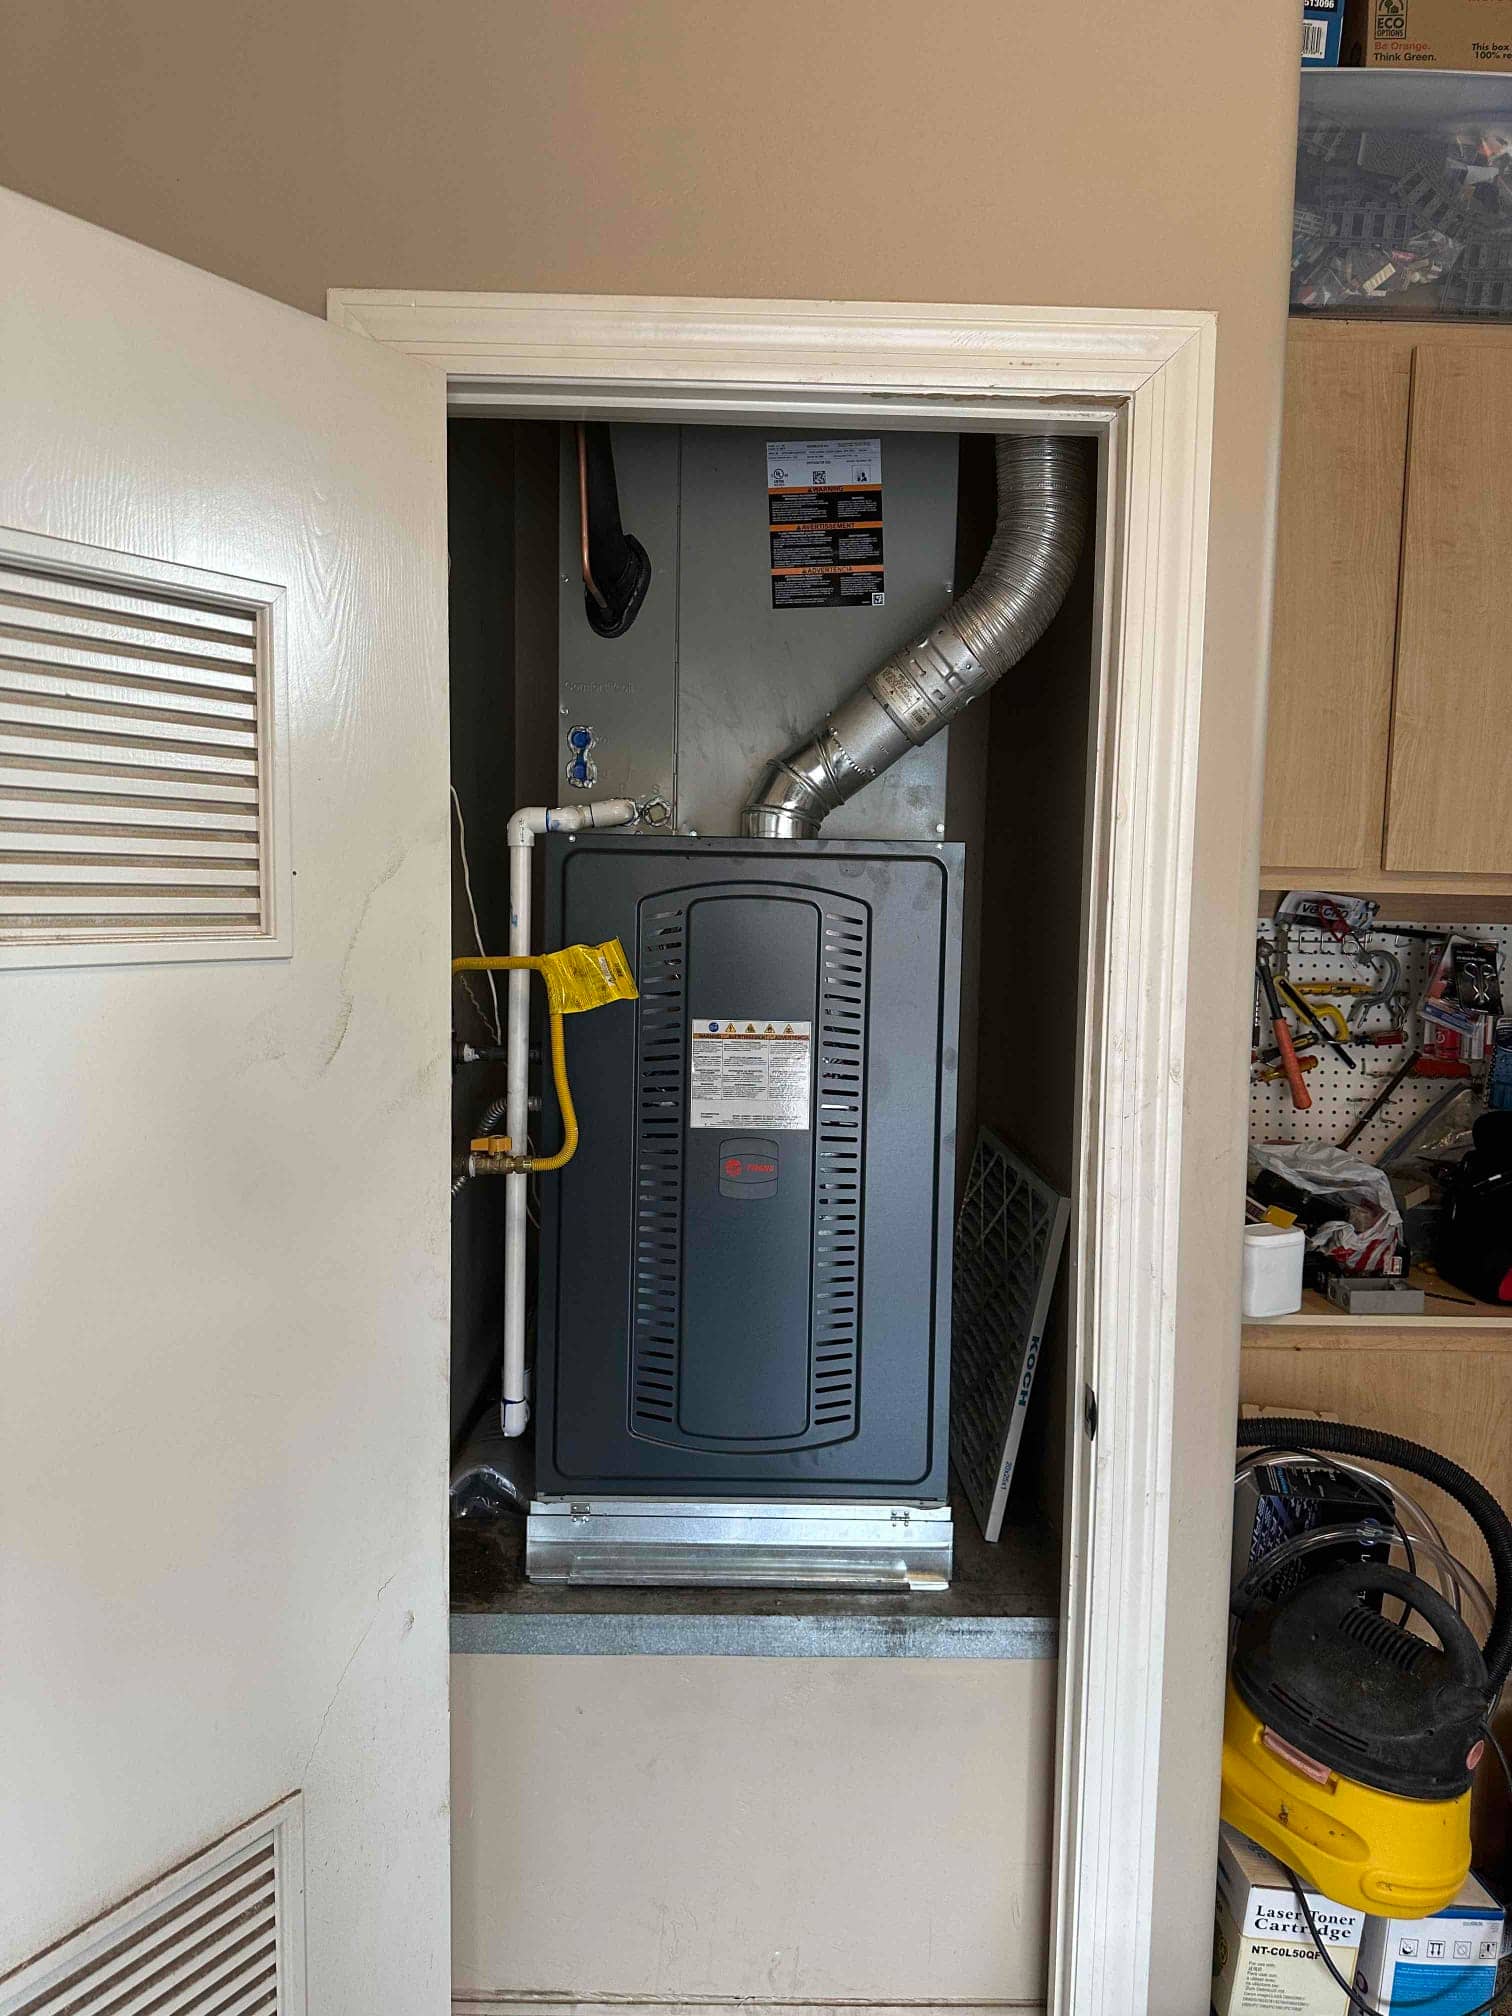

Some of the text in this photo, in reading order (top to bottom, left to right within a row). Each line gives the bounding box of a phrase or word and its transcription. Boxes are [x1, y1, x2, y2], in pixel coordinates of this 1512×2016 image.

[1377, 17, 1404, 29] ECO
[1376, 29, 1404, 37] OPTIONS
[1391, 42, 1431, 51] Orange.
[1472, 42, 1510, 51] This box
[1374, 53, 1437, 61] Think Green.
[1475, 51, 1501, 59] 100%
[1018, 1336, 1041, 1407] KOCH
[1256, 1905, 1356, 1925] Laser Toner
[1255, 1918, 1351, 1941] Cartrdge
